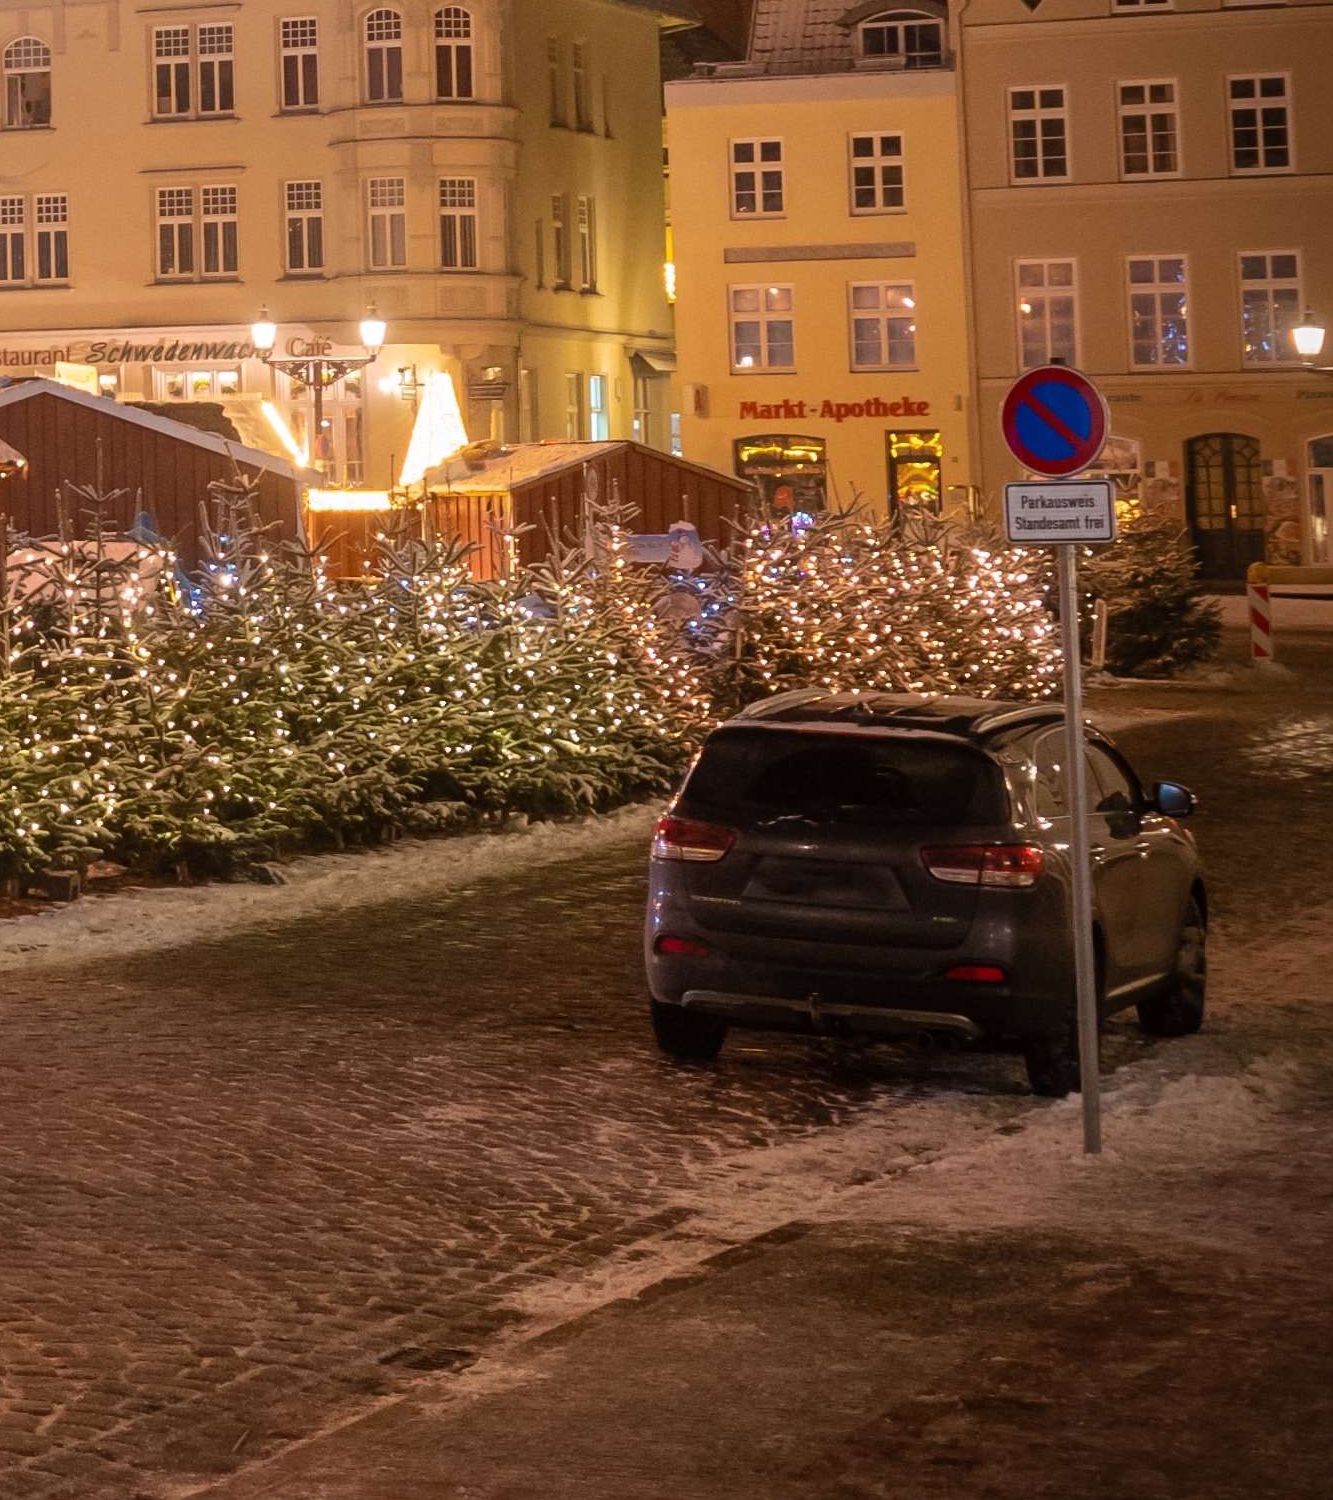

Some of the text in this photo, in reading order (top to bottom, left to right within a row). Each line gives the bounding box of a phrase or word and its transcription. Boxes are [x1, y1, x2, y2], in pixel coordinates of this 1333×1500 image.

[289, 336, 333, 358] Café
[1020, 493, 1095, 509] Parkausweis
[1015, 514, 1105, 531] Standesamt frei
